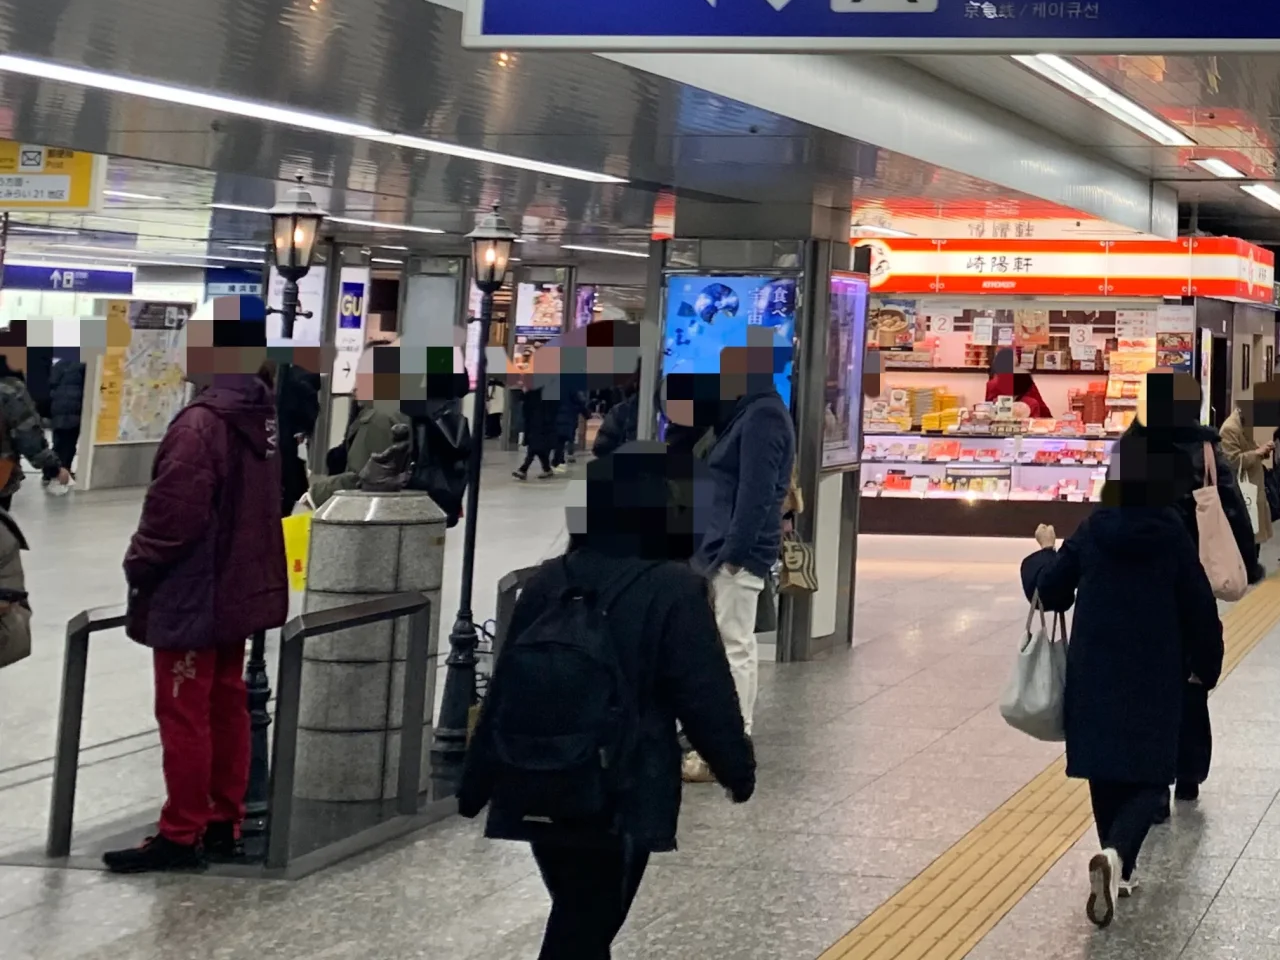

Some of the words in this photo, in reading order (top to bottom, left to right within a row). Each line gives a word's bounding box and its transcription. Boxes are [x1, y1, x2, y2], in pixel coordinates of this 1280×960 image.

[966, 255, 1033, 273] 崎陽軒
[340, 294, 364, 317] GU
[937, 317, 947, 331] 2
[1075, 328, 1086, 343] 3
